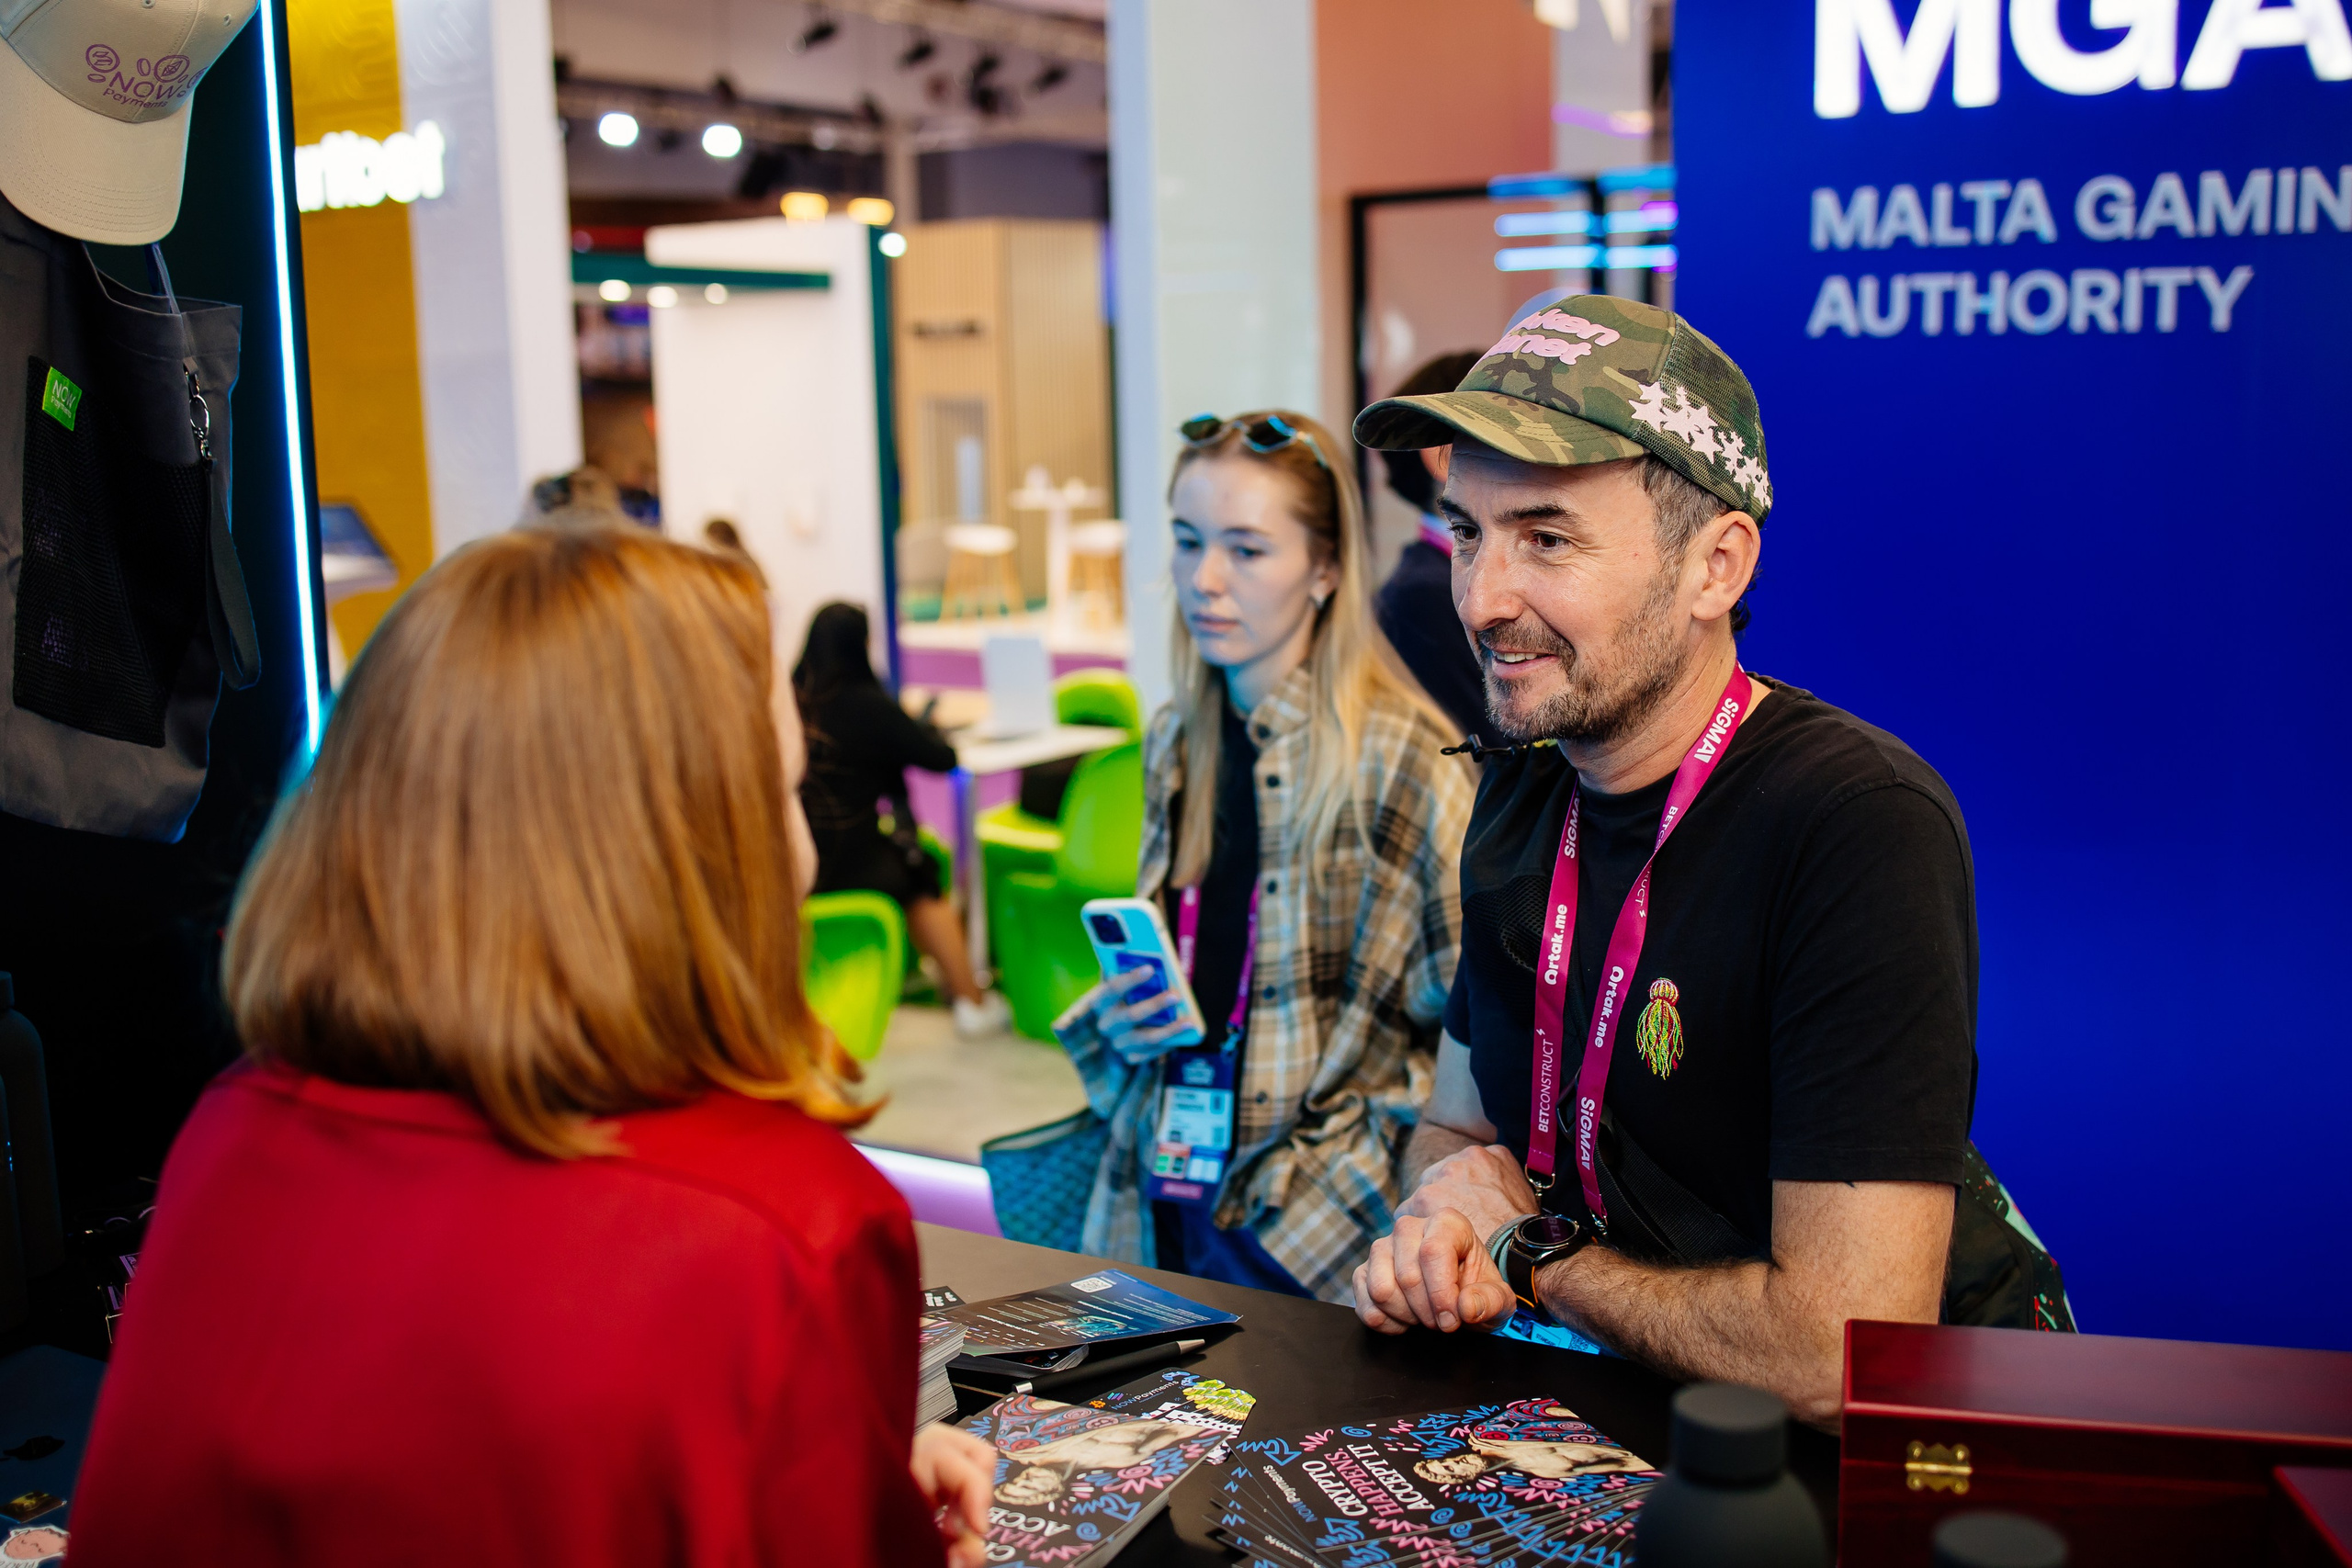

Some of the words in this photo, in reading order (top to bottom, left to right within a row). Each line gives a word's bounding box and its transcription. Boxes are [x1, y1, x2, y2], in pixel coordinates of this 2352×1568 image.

[103, 87, 169, 108] Payments
[108, 71, 183, 100] NOW
[1810, 178, 2058, 251] MALTA
[1805, 265, 2255, 339] AUTHORITY
[51, 379, 75, 409] NOW
[1544, 904, 1567, 985] Ortak.me
[1595, 965, 1624, 1048] Ortak.me
[1538, 1038, 1554, 1133] BETCONSTRUCT
[1347, 1443, 1379, 1459] IT
[1262, 1464, 1317, 1523] NOWPayments
[1302, 1460, 1368, 1517] CRYPTO
[1324, 1448, 1404, 1517] HAPPENS.
[1362, 1459, 1435, 1510] ACCEPT
[989, 1506, 1071, 1537] ACCE
